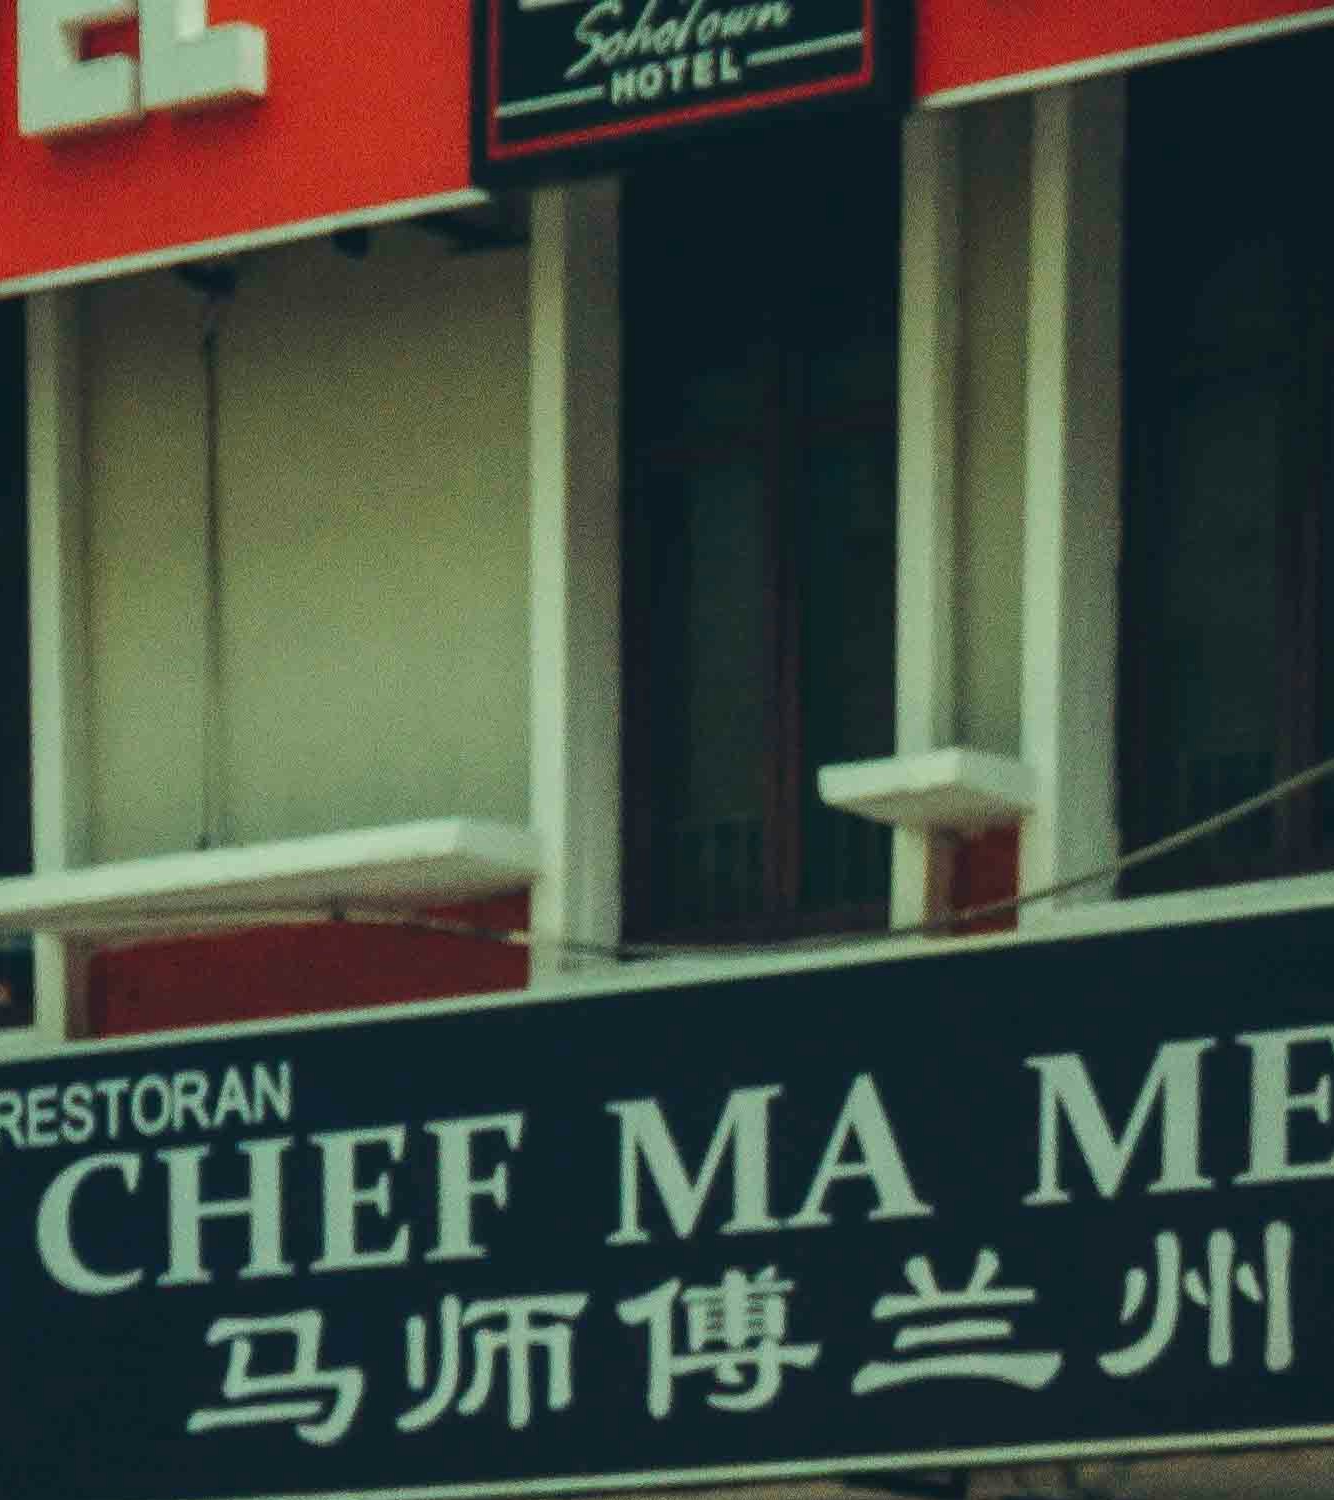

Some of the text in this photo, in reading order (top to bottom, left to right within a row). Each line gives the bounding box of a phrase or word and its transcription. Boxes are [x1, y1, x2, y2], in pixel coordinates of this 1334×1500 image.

[610, 47, 742, 104] HOTEL
[35, 1111, 525, 1296] CHEF
[605, 1072, 934, 1246] MA
